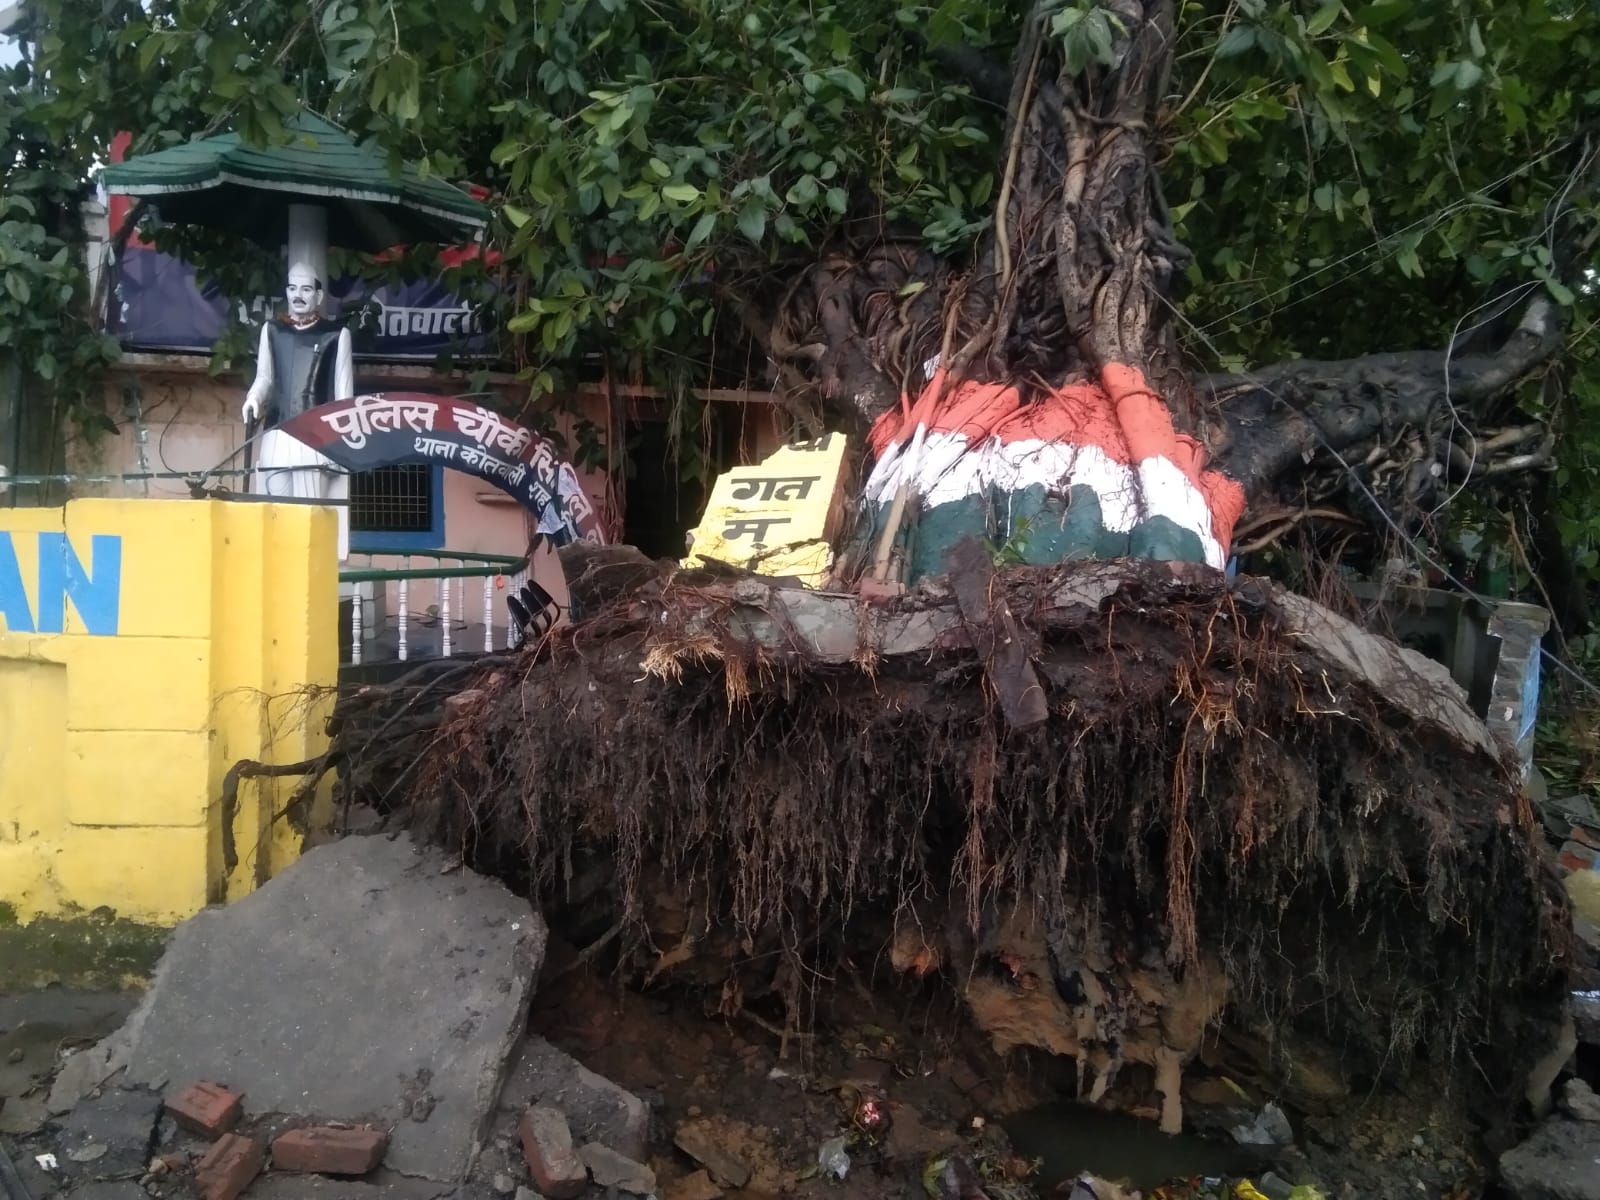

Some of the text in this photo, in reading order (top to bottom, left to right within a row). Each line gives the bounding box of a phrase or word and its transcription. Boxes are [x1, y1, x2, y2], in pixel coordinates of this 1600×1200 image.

[320, 393, 439, 450] पुलिस
[452, 406, 532, 459] चौकी
[414, 436, 459, 460] थाना
[460, 443, 527, 488] कोतवाली
[731, 475, 822, 502] गत
